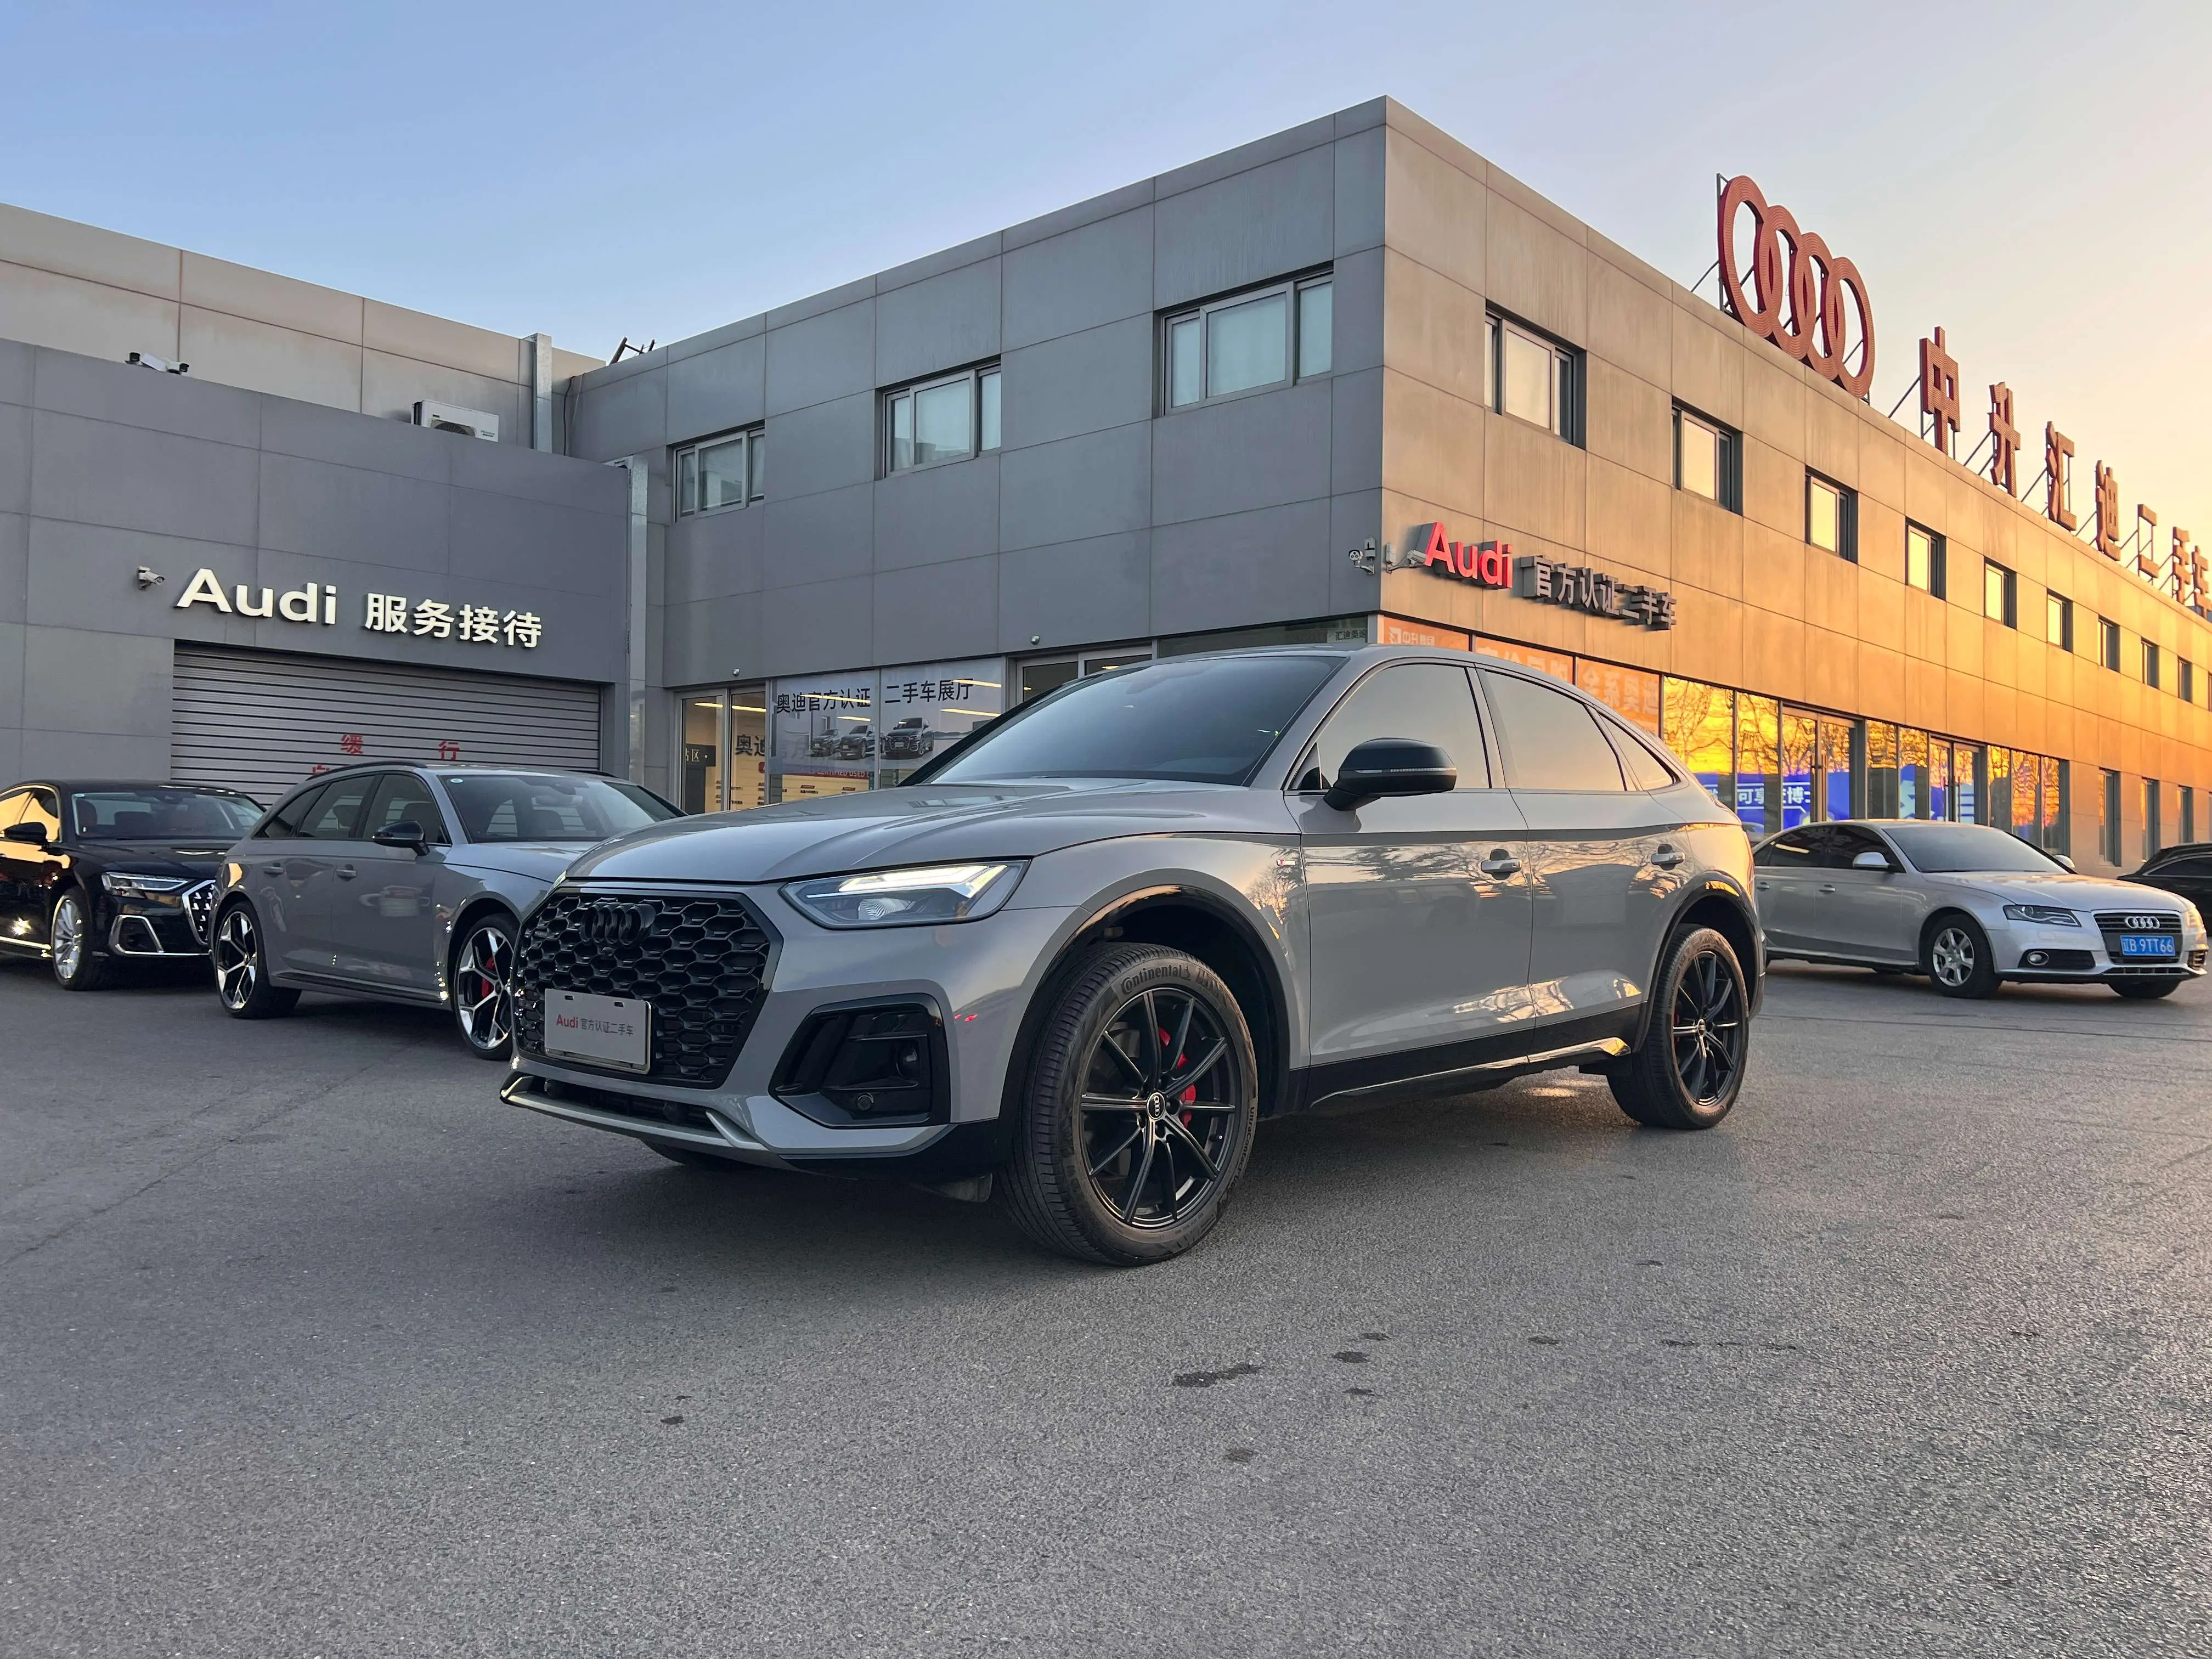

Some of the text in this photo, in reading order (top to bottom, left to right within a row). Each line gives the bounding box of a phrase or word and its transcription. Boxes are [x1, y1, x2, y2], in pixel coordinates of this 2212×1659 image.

[1423, 522, 1677, 630] Audi 官方认证二手车
[175, 567, 543, 648] Audi 服务接待
[776, 678, 974, 714] 奥迪官方认证 二手车展厅
[439, 740, 460, 761] 行
[1120, 964, 1182, 995] Continental
[556, 1014, 634, 1037] Audi 官方认证二手车
